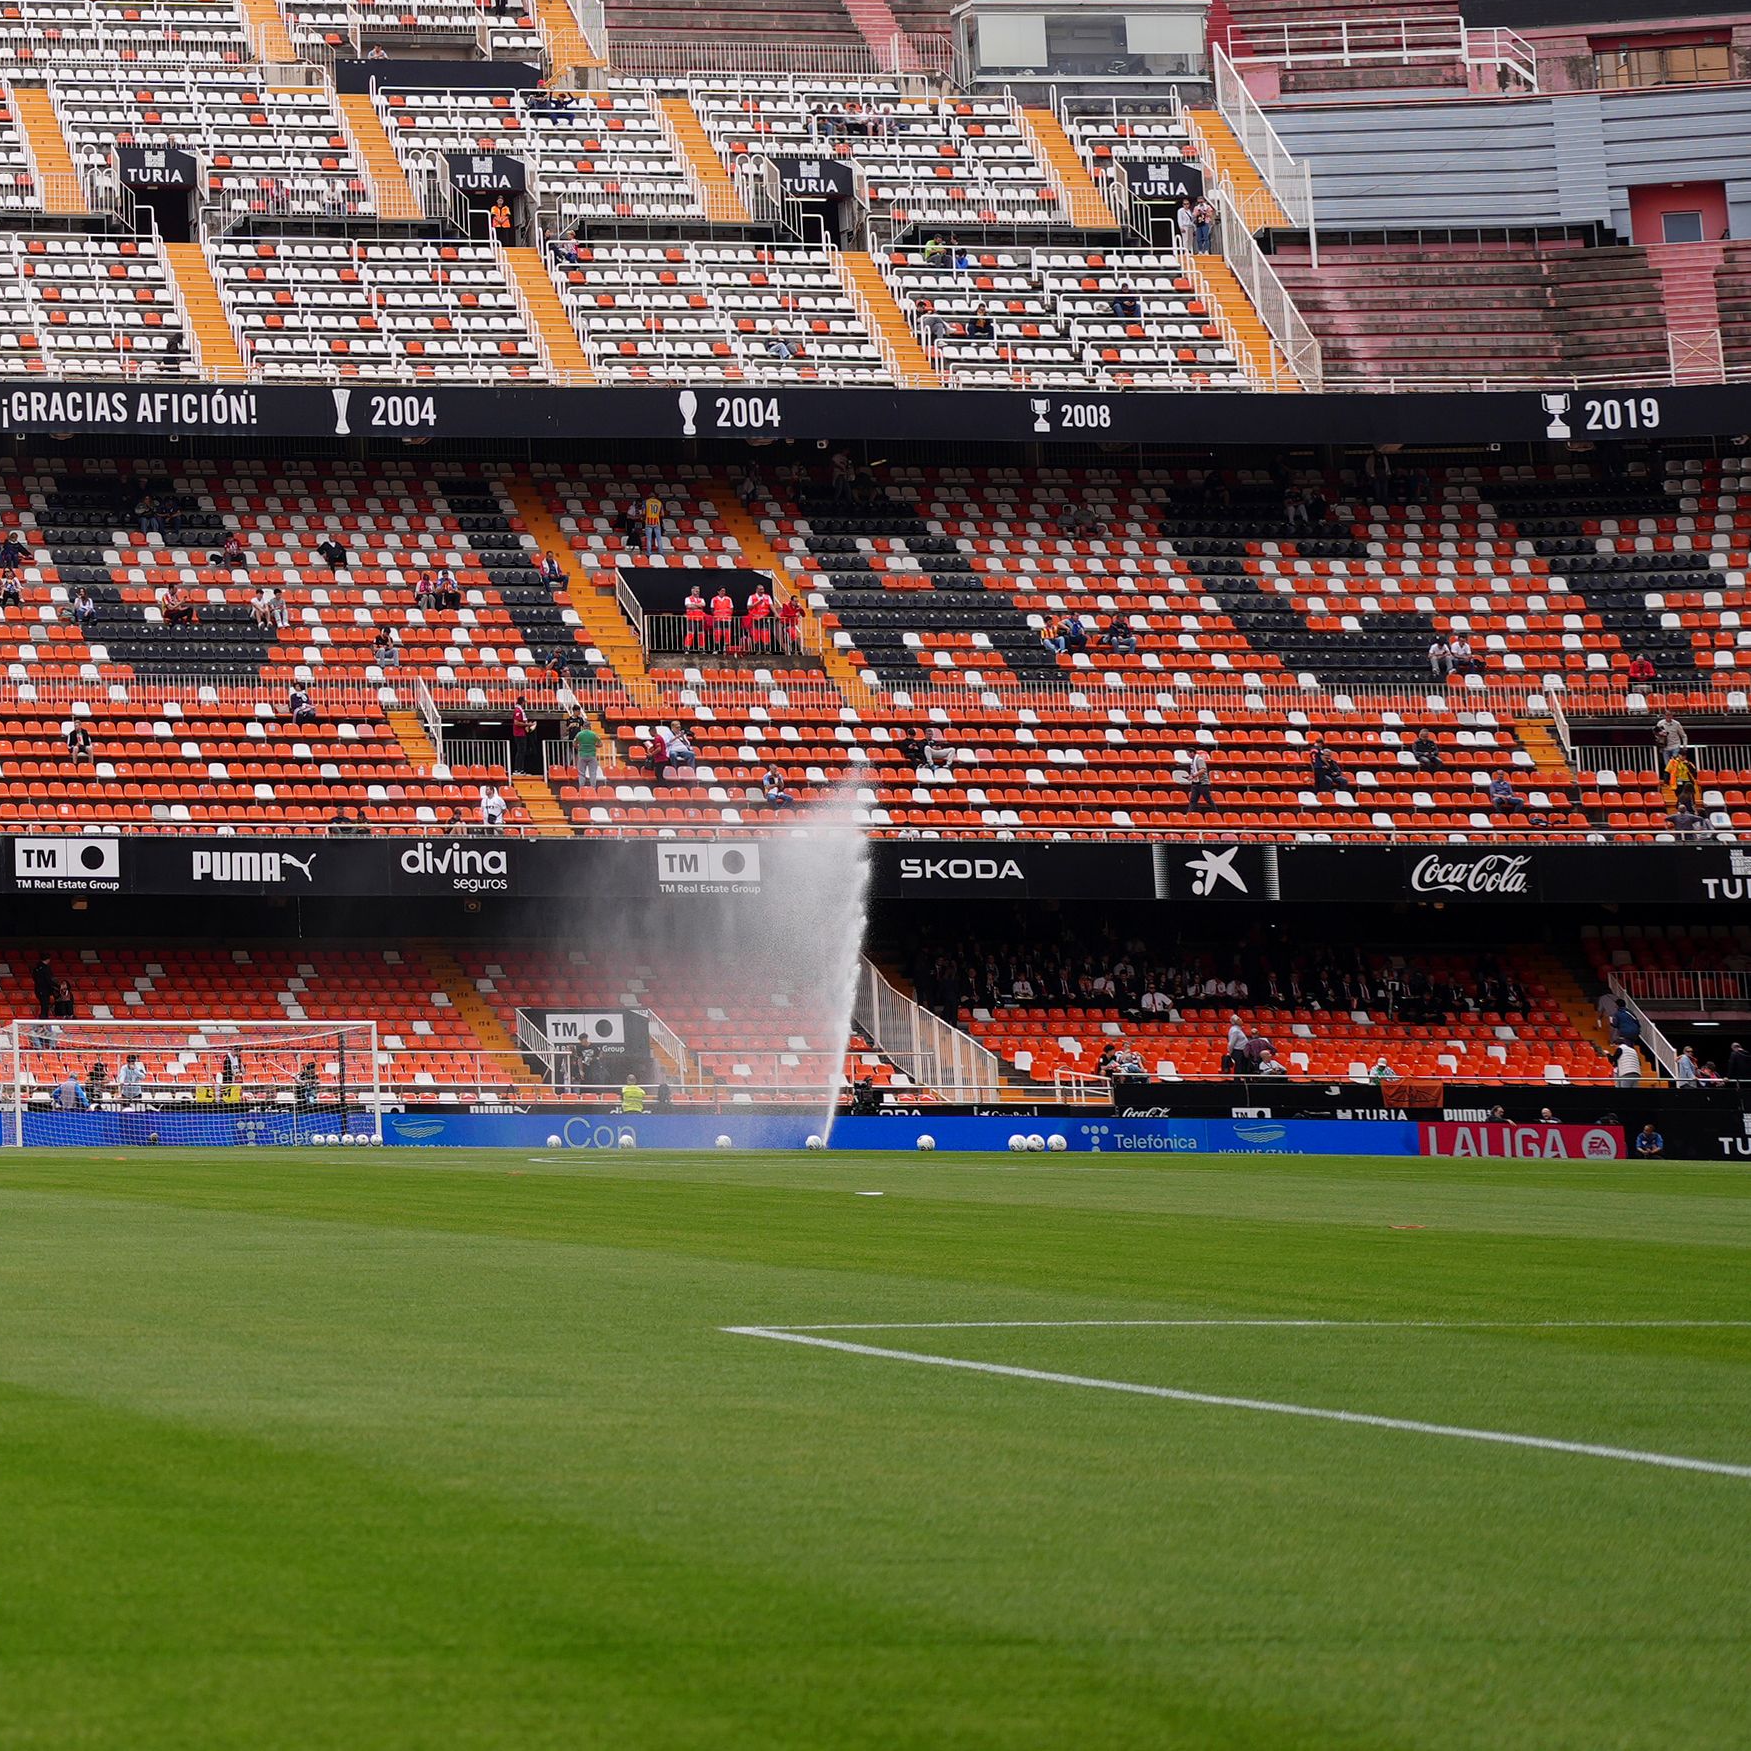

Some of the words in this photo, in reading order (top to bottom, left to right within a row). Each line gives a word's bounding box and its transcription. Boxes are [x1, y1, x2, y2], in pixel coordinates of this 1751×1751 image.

[127, 168, 184, 183] TURIA
[455, 174, 511, 189] TURIA
[782, 178, 839, 193] TURIA
[1133, 181, 1189, 197] TURIA
[138, 387, 258, 425] AFICIÓN!
[370, 395, 437, 427] 2004
[715, 396, 781, 428] 2004
[1584, 397, 1661, 430] 2019
[1060, 403, 1112, 428] 2008
[22, 848, 56, 868] TM
[192, 850, 281, 882] PUMA
[400, 841, 508, 874] divina
[664, 852, 699, 872] TM
[899, 858, 1025, 880] SKODA
[1411, 854, 1534, 893] Coca-Cola
[16, 879, 32, 889] TM
[33, 878, 55, 889] Real
[58, 878, 91, 890] Estate
[94, 879, 120, 893] Group
[452, 877, 508, 893] seguros
[659, 882, 676, 893] TM
[678, 882, 698, 893] Real
[701, 882, 733, 893] Estate
[735, 883, 762, 896] Group
[551, 1021, 578, 1037] TM
[602, 1044, 625, 1055] Group
[1355, 1108, 1408, 1121] TURIA
[1113, 1132, 1198, 1150] Telefónica
[1428, 1125, 1569, 1159] LALIGA
[1587, 1136, 1610, 1148] EA
[1587, 1148, 1612, 1156] SPORTS
